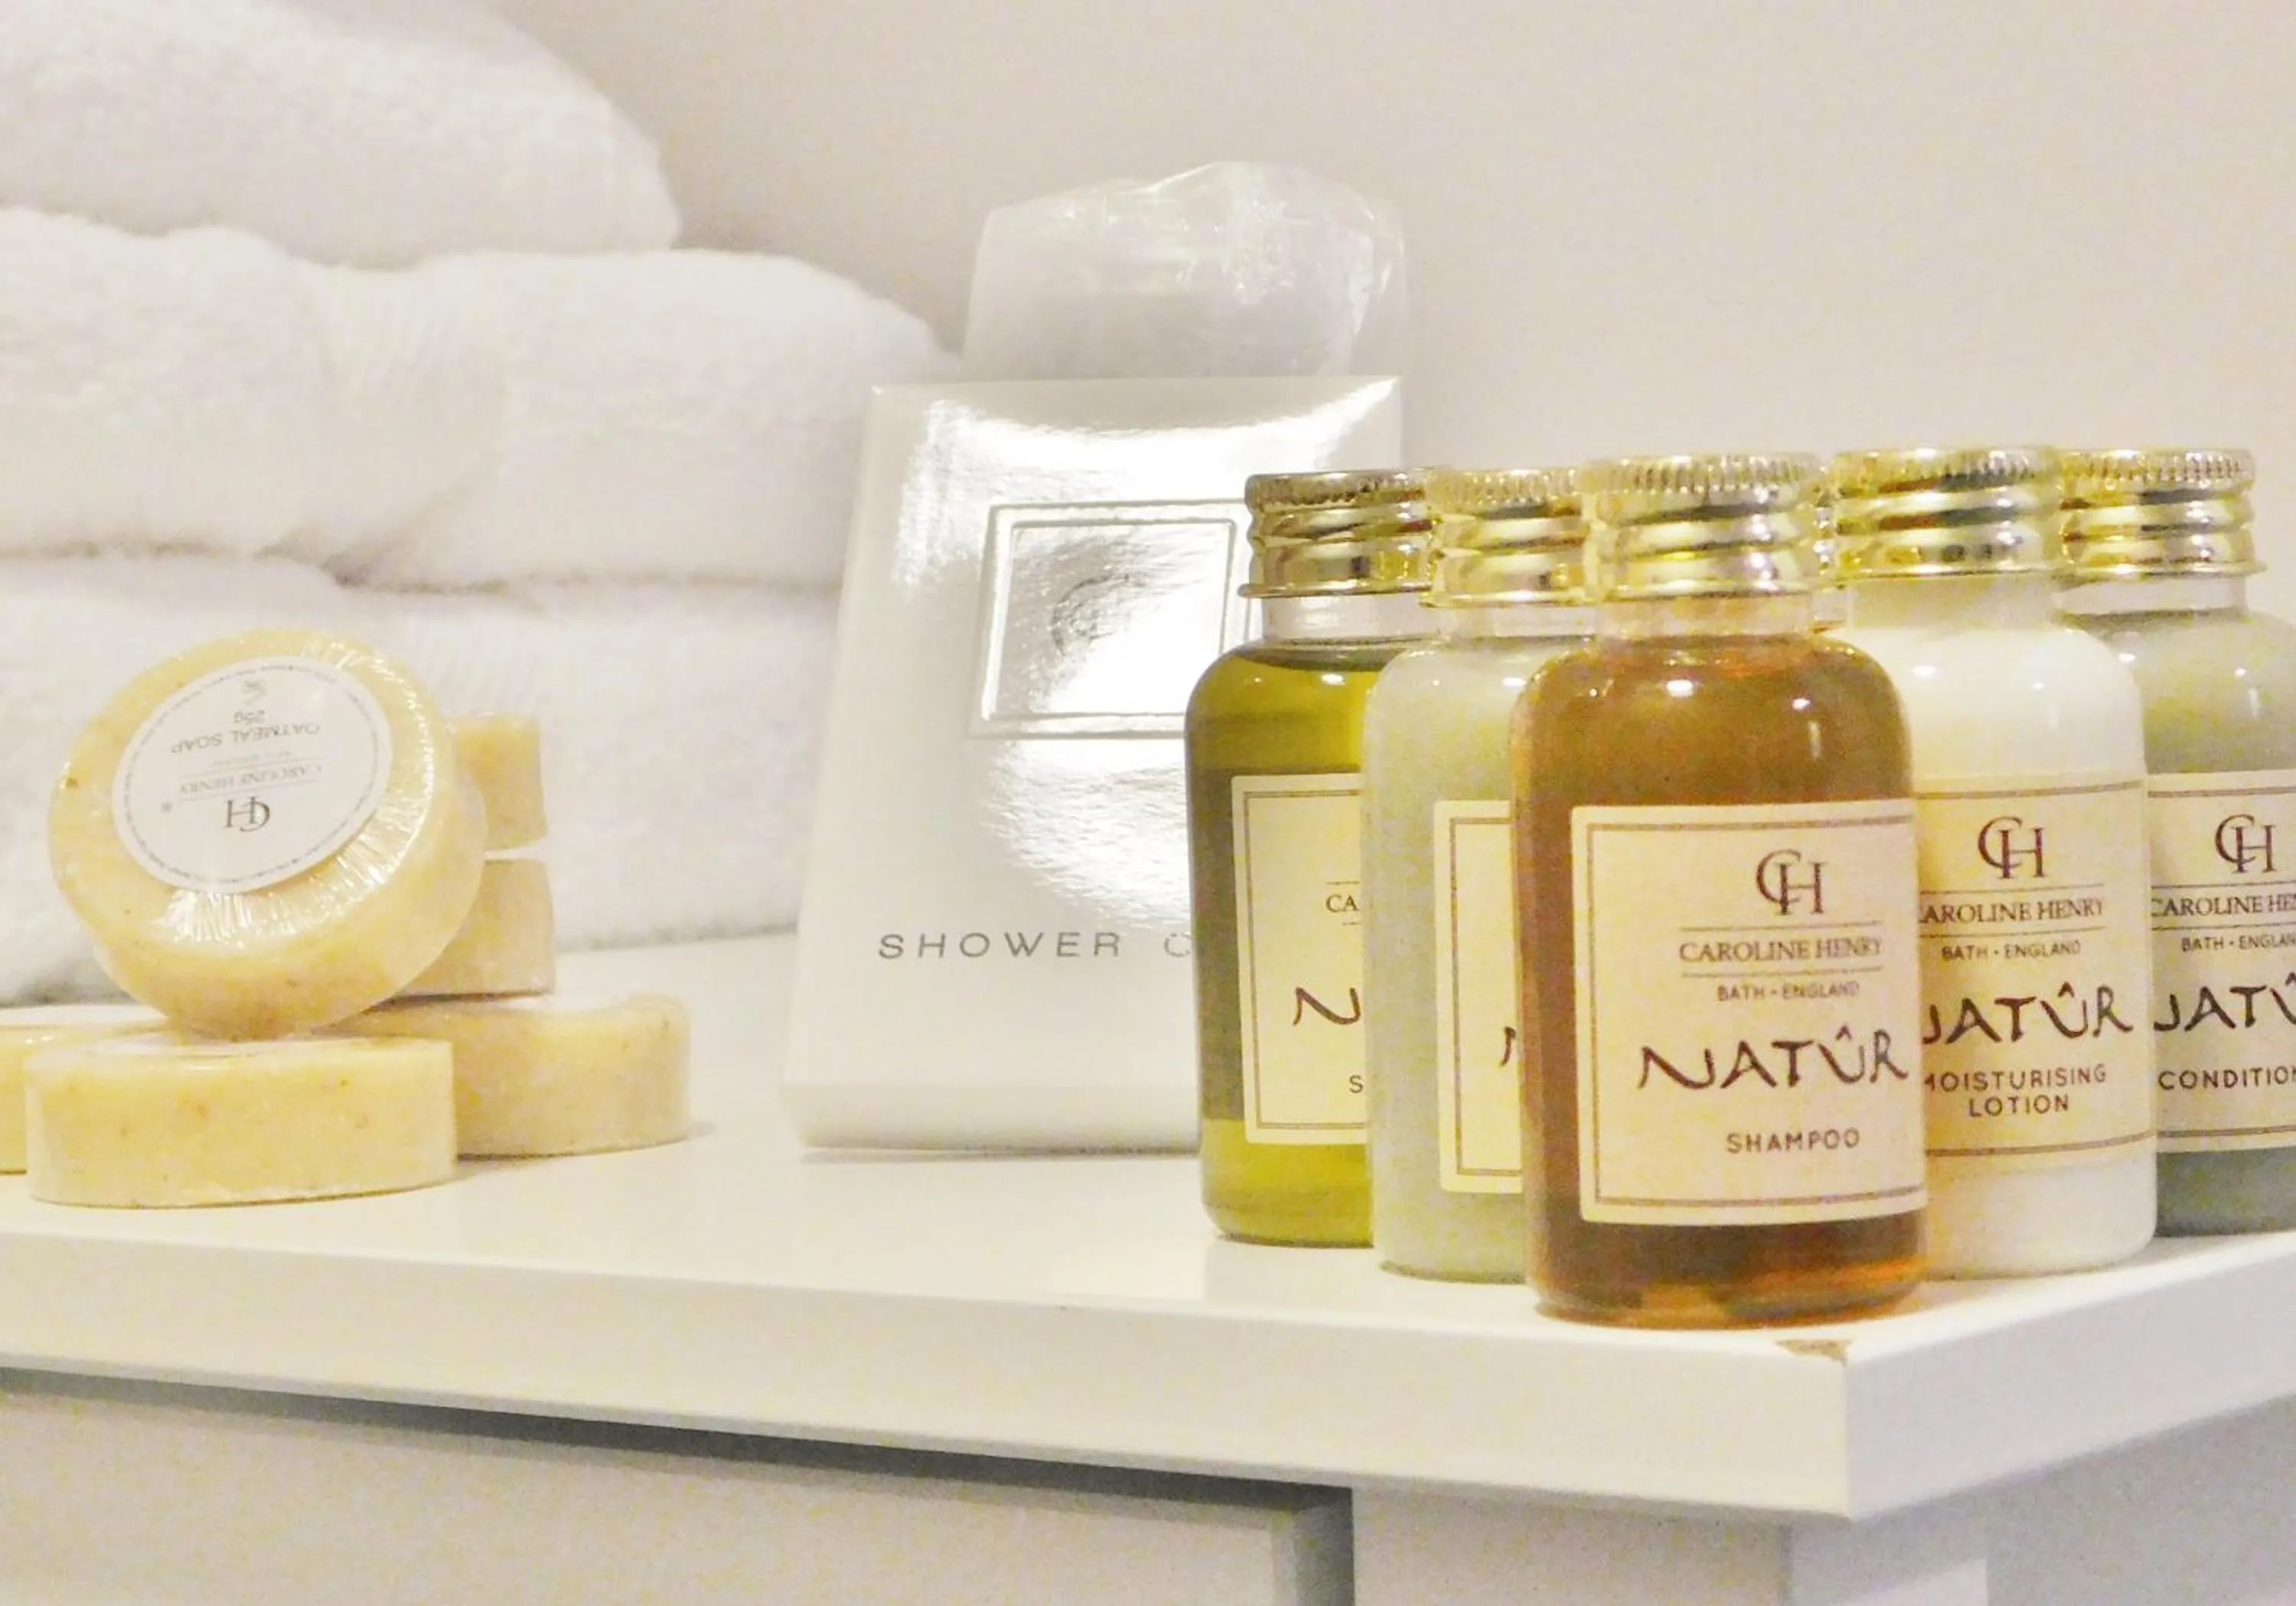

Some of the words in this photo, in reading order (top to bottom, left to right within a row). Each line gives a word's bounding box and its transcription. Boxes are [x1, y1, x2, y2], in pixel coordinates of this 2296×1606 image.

[171, 733, 222, 755] SOAP
[232, 722, 320, 743] OATMEAL
[1918, 900, 2032, 924] AROLINE
[2037, 896, 2105, 920] HENRY
[878, 932, 1121, 959] SHOWER
[1679, 938, 1810, 963] CAROLINE
[1815, 936, 1883, 958] HENRY
[1942, 942, 1989, 961] BATH
[2004, 939, 2082, 959] ENGLAND
[2181, 935, 2224, 952] BATH
[2239, 932, 2296, 950] ENGLAN
[1717, 984, 1764, 1002] BATH
[1782, 980, 1861, 1000] ENGLAND
[2157, 1065, 2296, 1091] CONDITIO
[1968, 1094, 2070, 1119] LOTION
[1726, 1128, 1861, 1154] SHAMPOO
